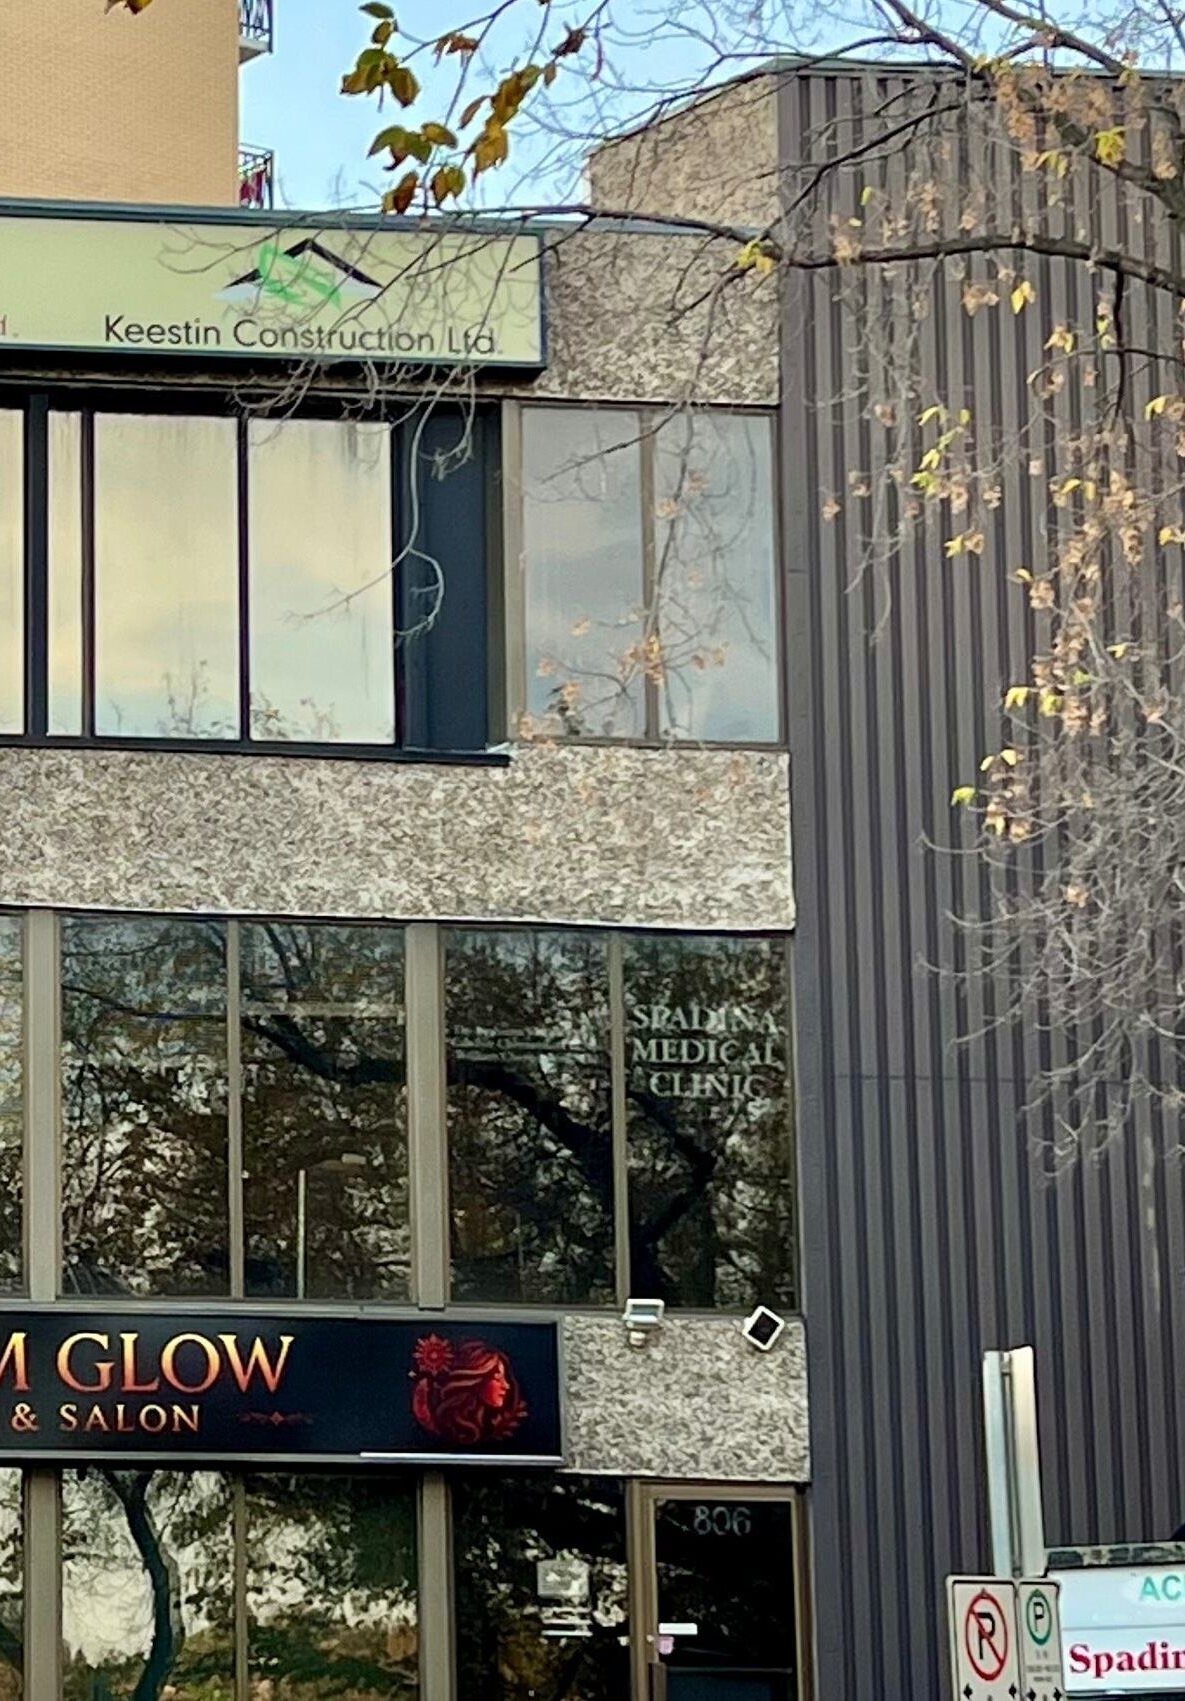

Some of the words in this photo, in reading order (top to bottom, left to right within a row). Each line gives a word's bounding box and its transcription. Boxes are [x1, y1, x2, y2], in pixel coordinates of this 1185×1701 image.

[105, 315, 221, 346] Keestin
[234, 319, 435, 353] Construction
[633, 1004, 778, 1034] SPADINA
[633, 1038, 784, 1069] MEDICAL
[650, 1072, 767, 1099] CLINIC
[56, 1332, 296, 1394] GLOW
[11, 1403, 39, 1432] &
[60, 1404, 200, 1433] SALON
[693, 1505, 752, 1536] 806
[1139, 1574, 1185, 1601] AC
